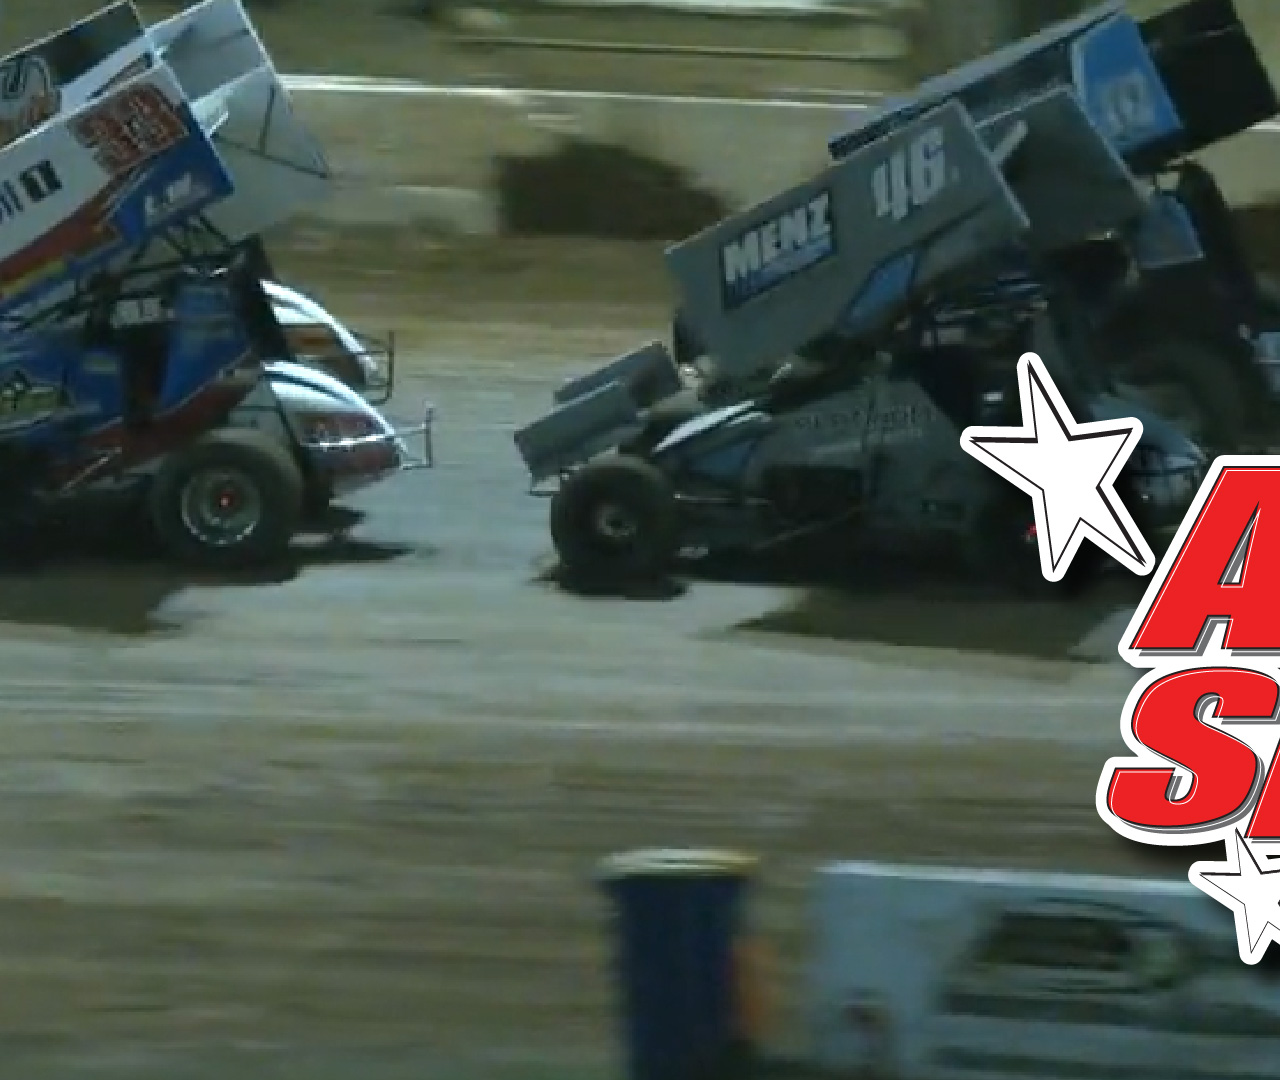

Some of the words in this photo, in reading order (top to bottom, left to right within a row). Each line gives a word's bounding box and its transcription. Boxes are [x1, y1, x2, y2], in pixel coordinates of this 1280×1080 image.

[21, 158, 63, 204] 1
[872, 126, 946, 221] 46
[723, 190, 832, 284] MENZ
